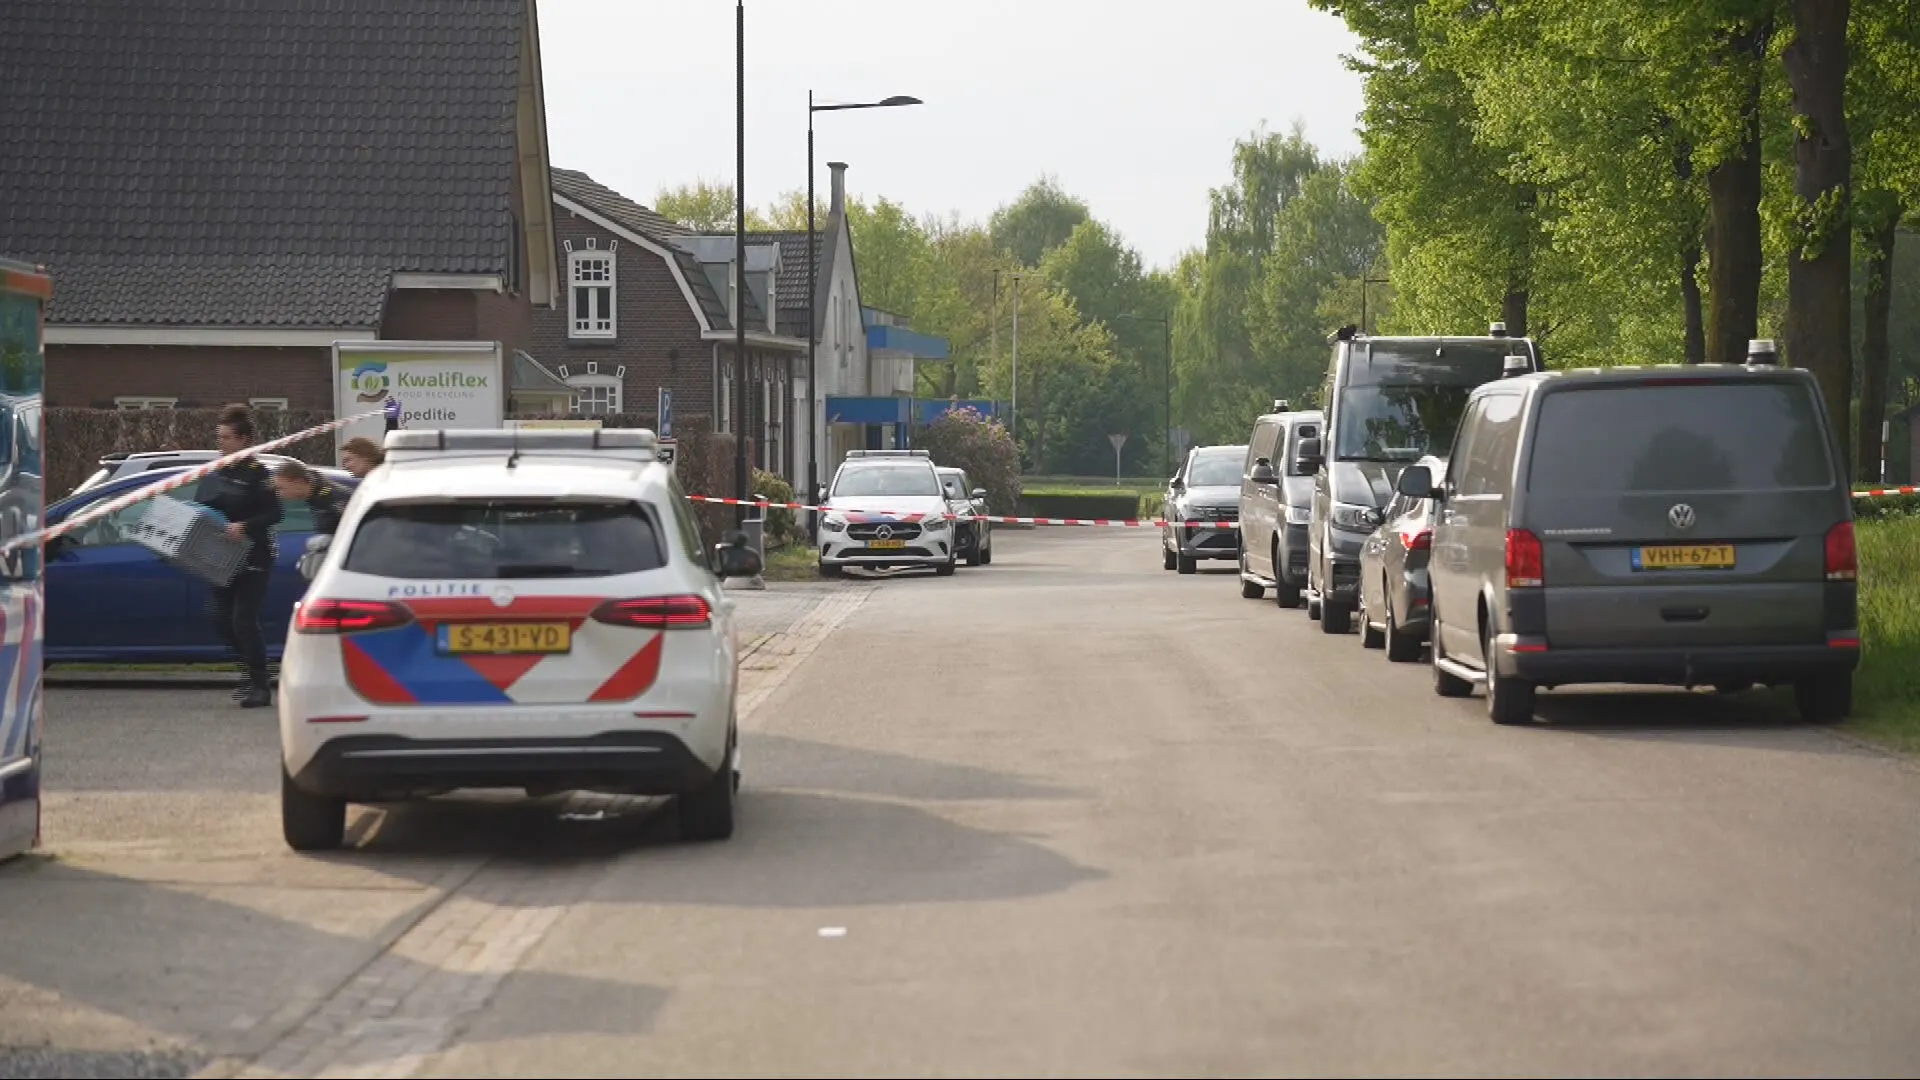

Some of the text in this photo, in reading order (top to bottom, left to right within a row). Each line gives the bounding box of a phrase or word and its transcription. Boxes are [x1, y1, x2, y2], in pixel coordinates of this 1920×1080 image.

[397, 371, 488, 388] Kwaliflex
[398, 391, 475, 399] FOOD RECYCLING
[403, 408, 456, 422] peditie
[664, 393, 671, 421] P
[1644, 547, 1729, 563] VHH-67-T
[388, 584, 482, 596] POLITIE
[459, 626, 559, 647] S-431-VD
